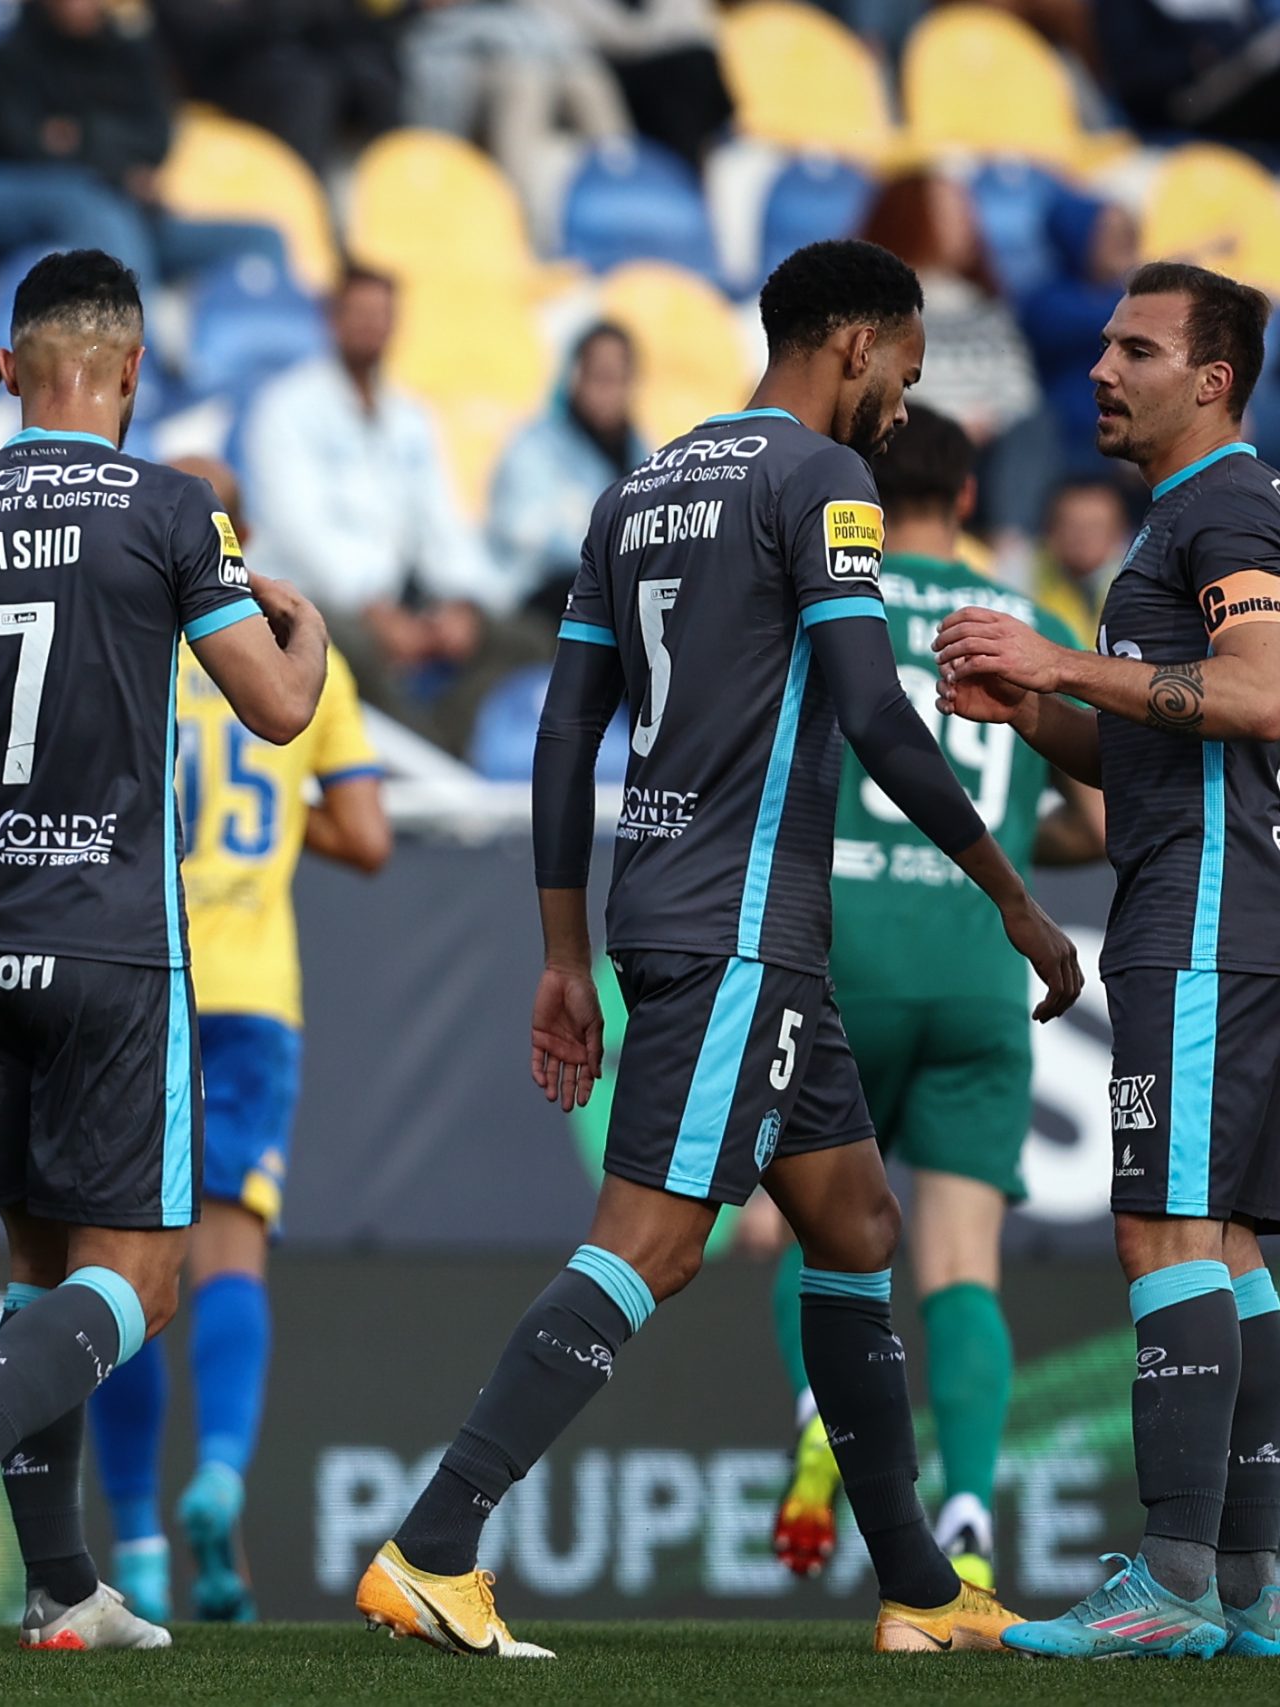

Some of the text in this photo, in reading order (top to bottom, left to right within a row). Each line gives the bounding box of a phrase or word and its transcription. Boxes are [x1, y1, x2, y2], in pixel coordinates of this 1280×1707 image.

[684, 465, 748, 483] LOGISTICS
[24, 494, 38, 509] &
[43, 491, 130, 509] LOGISTICS
[833, 511, 856, 525] LIGA
[631, 577, 682, 758] 5
[49, 853, 110, 867] SEGUROS
[769, 1008, 803, 1091] 5
